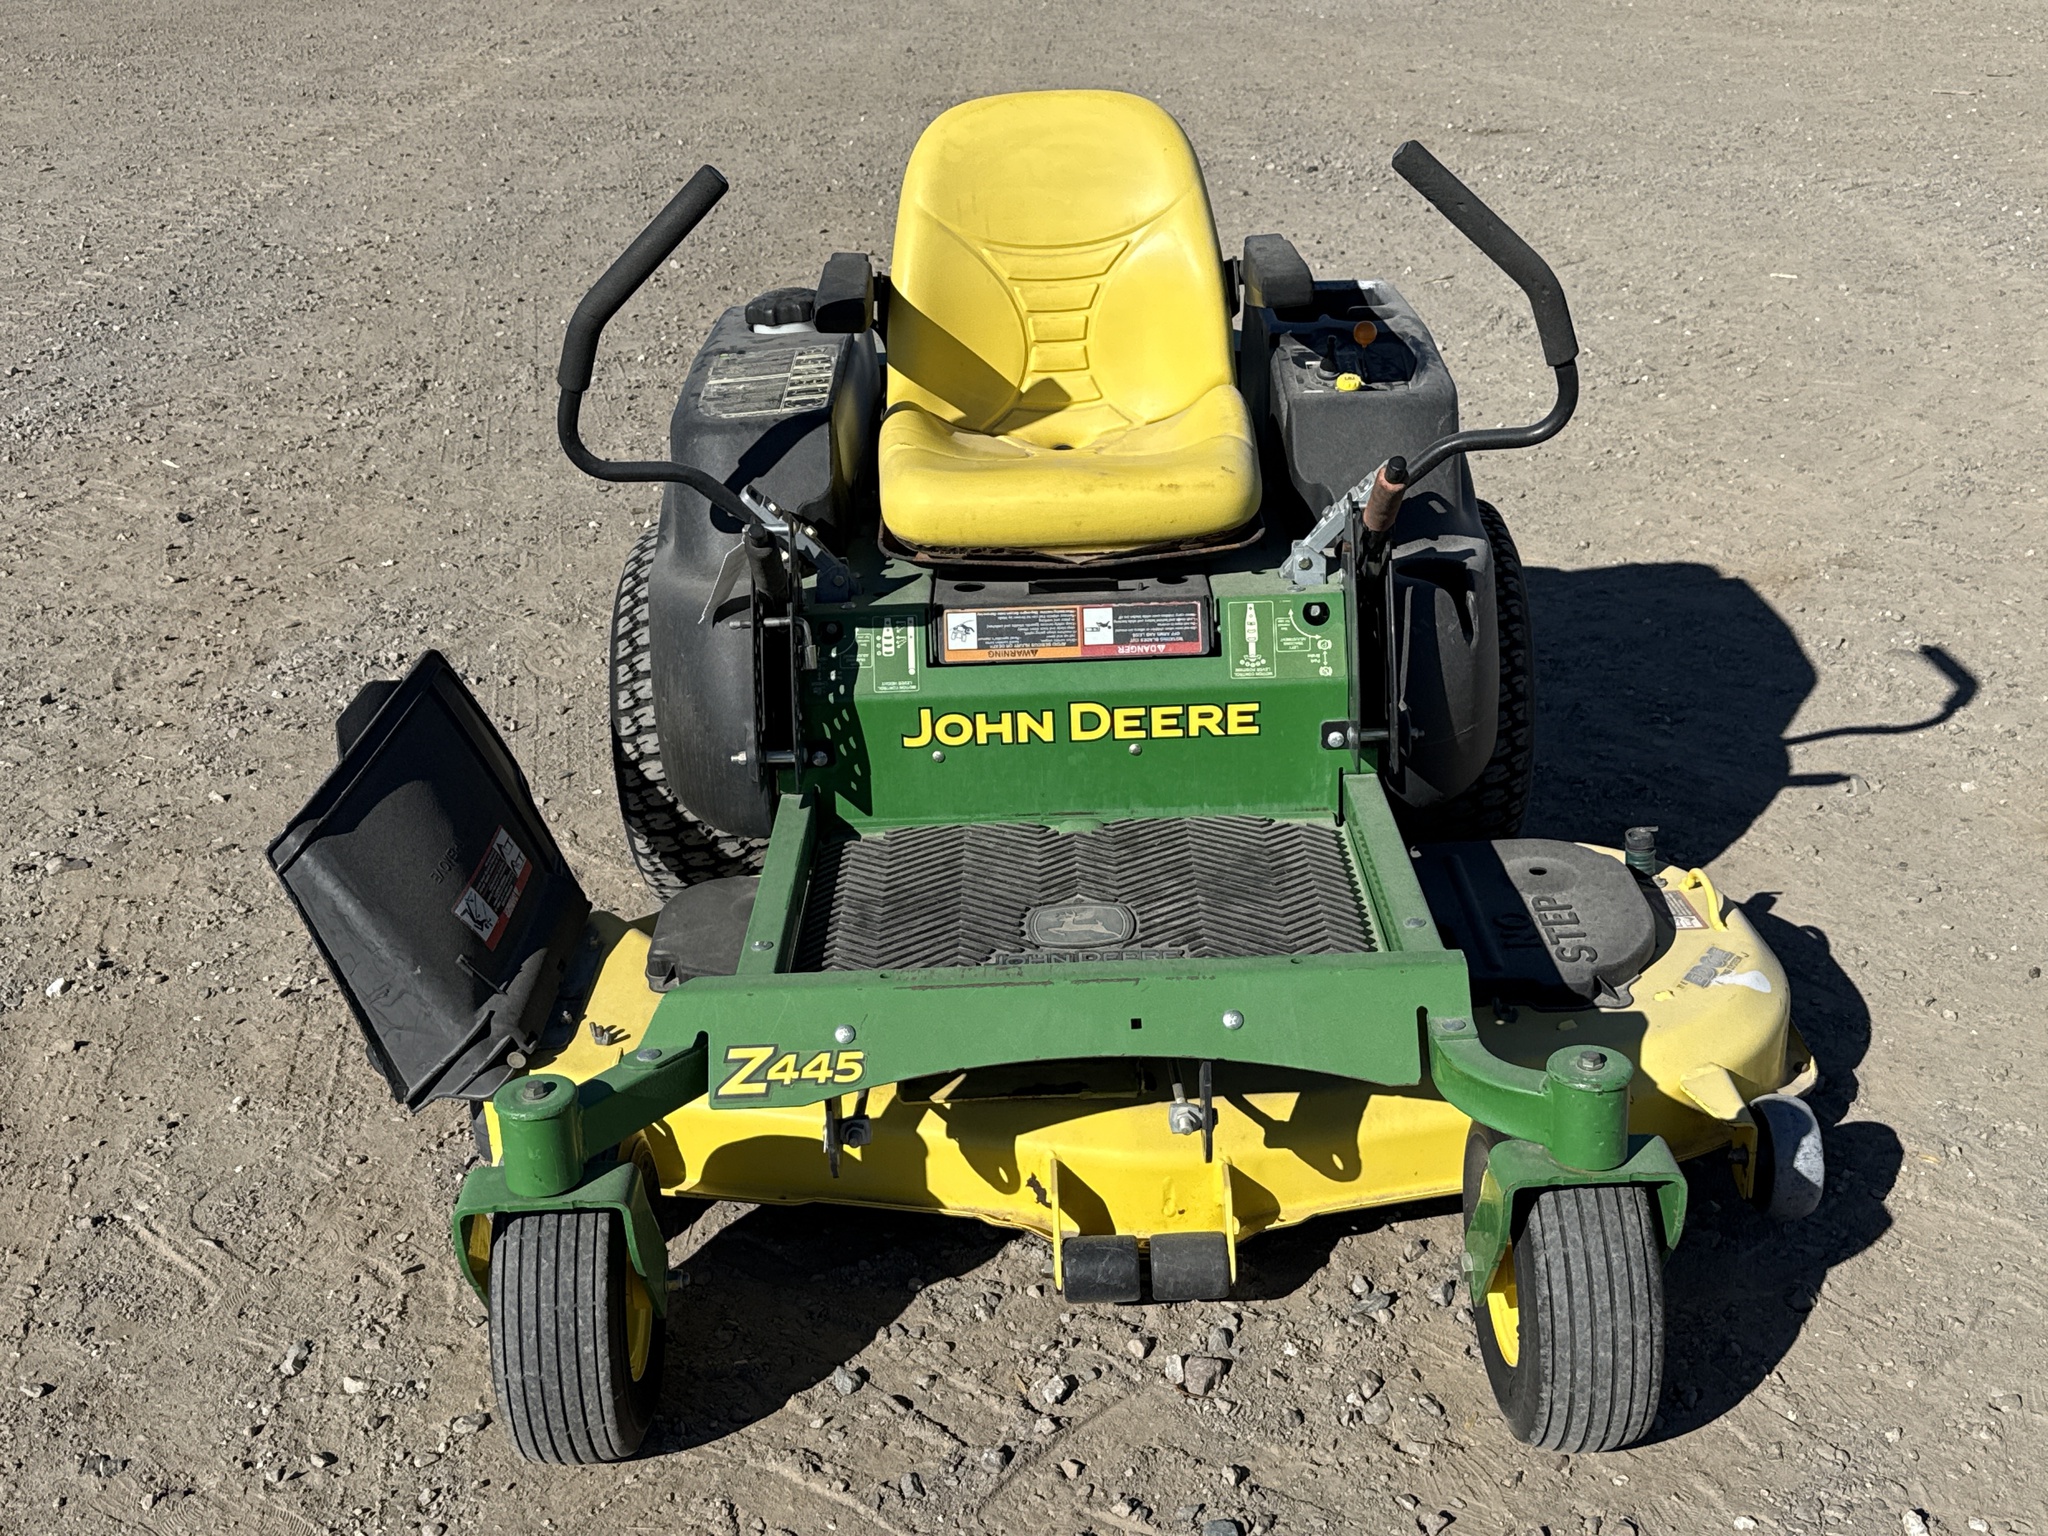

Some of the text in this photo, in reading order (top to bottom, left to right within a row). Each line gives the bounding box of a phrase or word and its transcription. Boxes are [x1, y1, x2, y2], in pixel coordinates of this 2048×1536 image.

[987, 650, 1031, 658] WARNING
[1117, 644, 1157, 654] DANGER
[902, 702, 1261, 748] JOHN DEERE
[1532, 896, 1598, 963] STEP
[995, 949, 1182, 965] JOHN DEERE
[1685, 945, 1736, 989] EDGE
[714, 1043, 866, 1099] Z445
